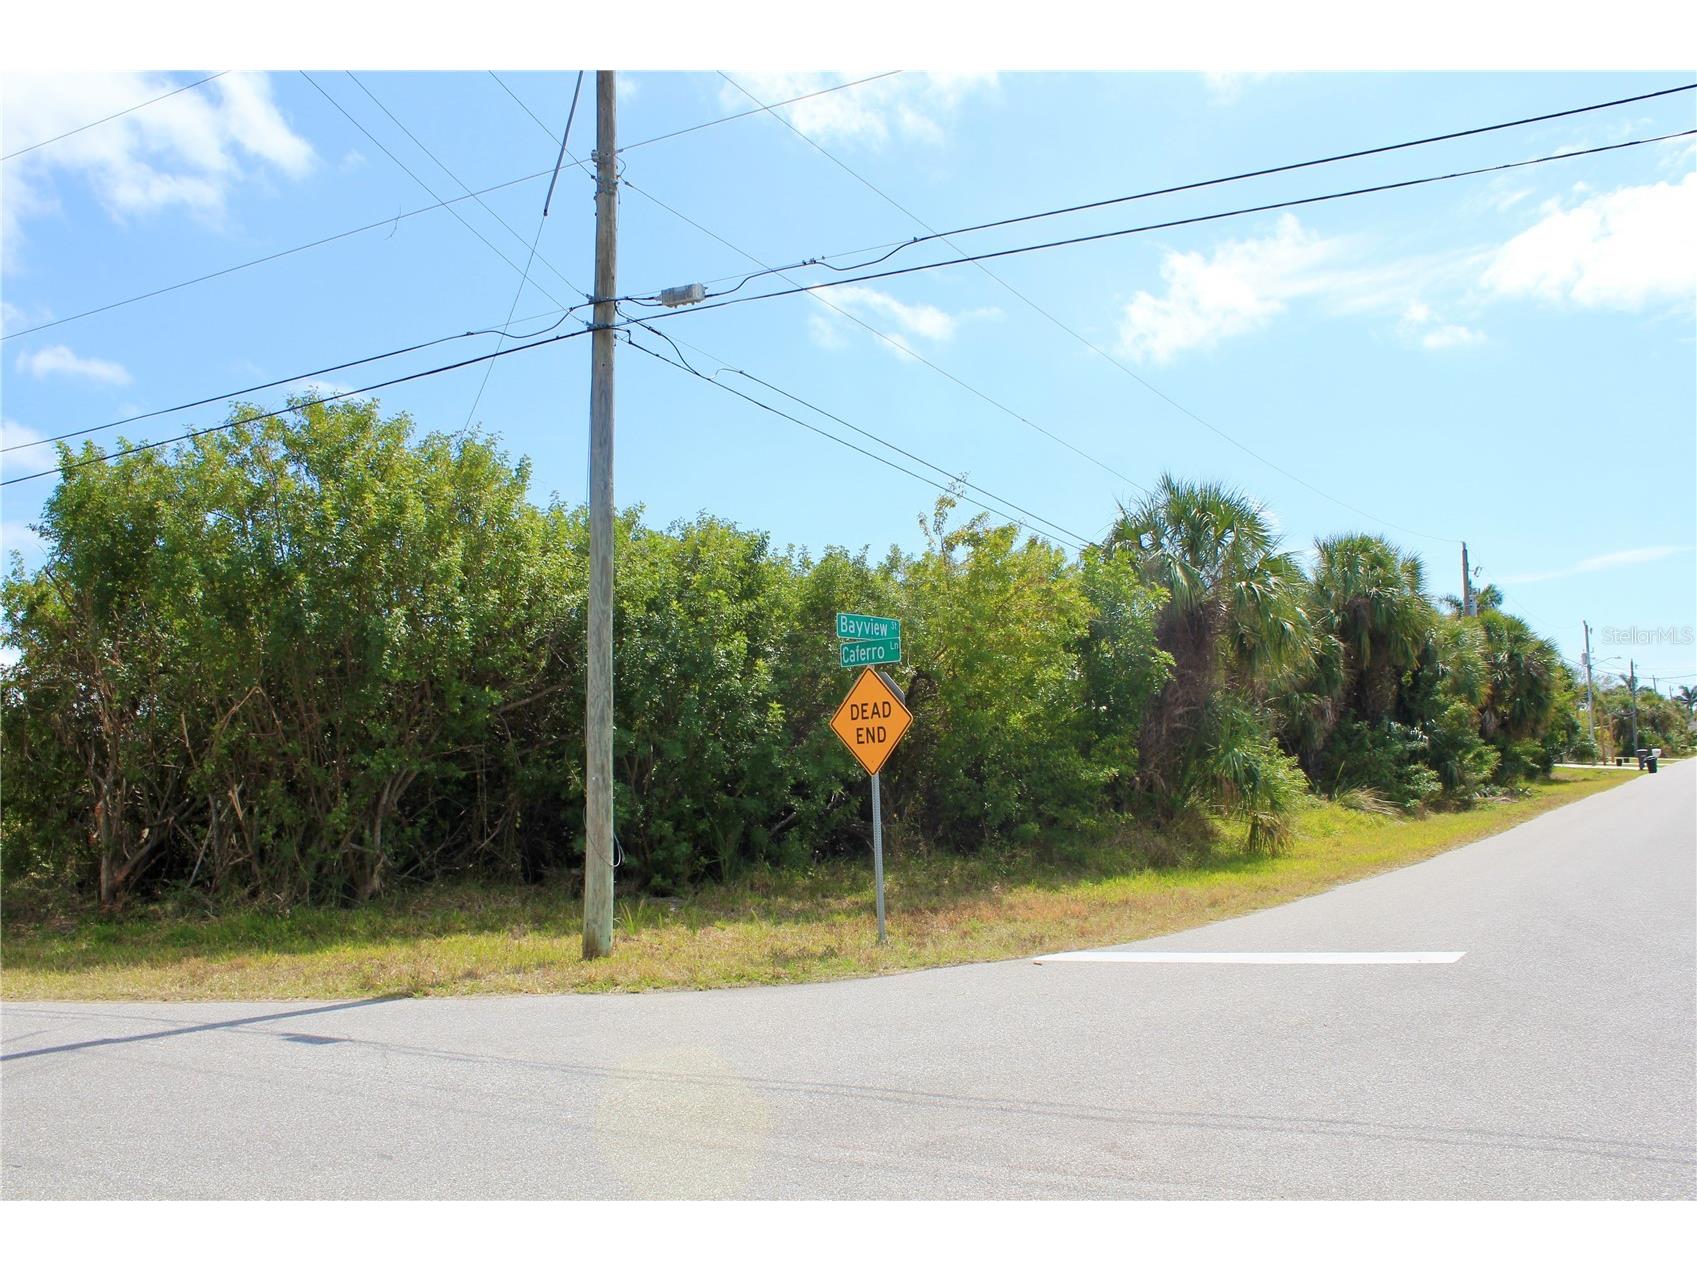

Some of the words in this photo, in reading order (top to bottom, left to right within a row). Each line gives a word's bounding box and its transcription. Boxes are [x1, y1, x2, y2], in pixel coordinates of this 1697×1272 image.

[840, 615, 888, 637] Bayview
[890, 621, 897, 630] St
[842, 645, 884, 663] Caferro
[890, 641, 899, 650] Ln
[851, 701, 891, 720] DEAD
[856, 726, 887, 744] END
